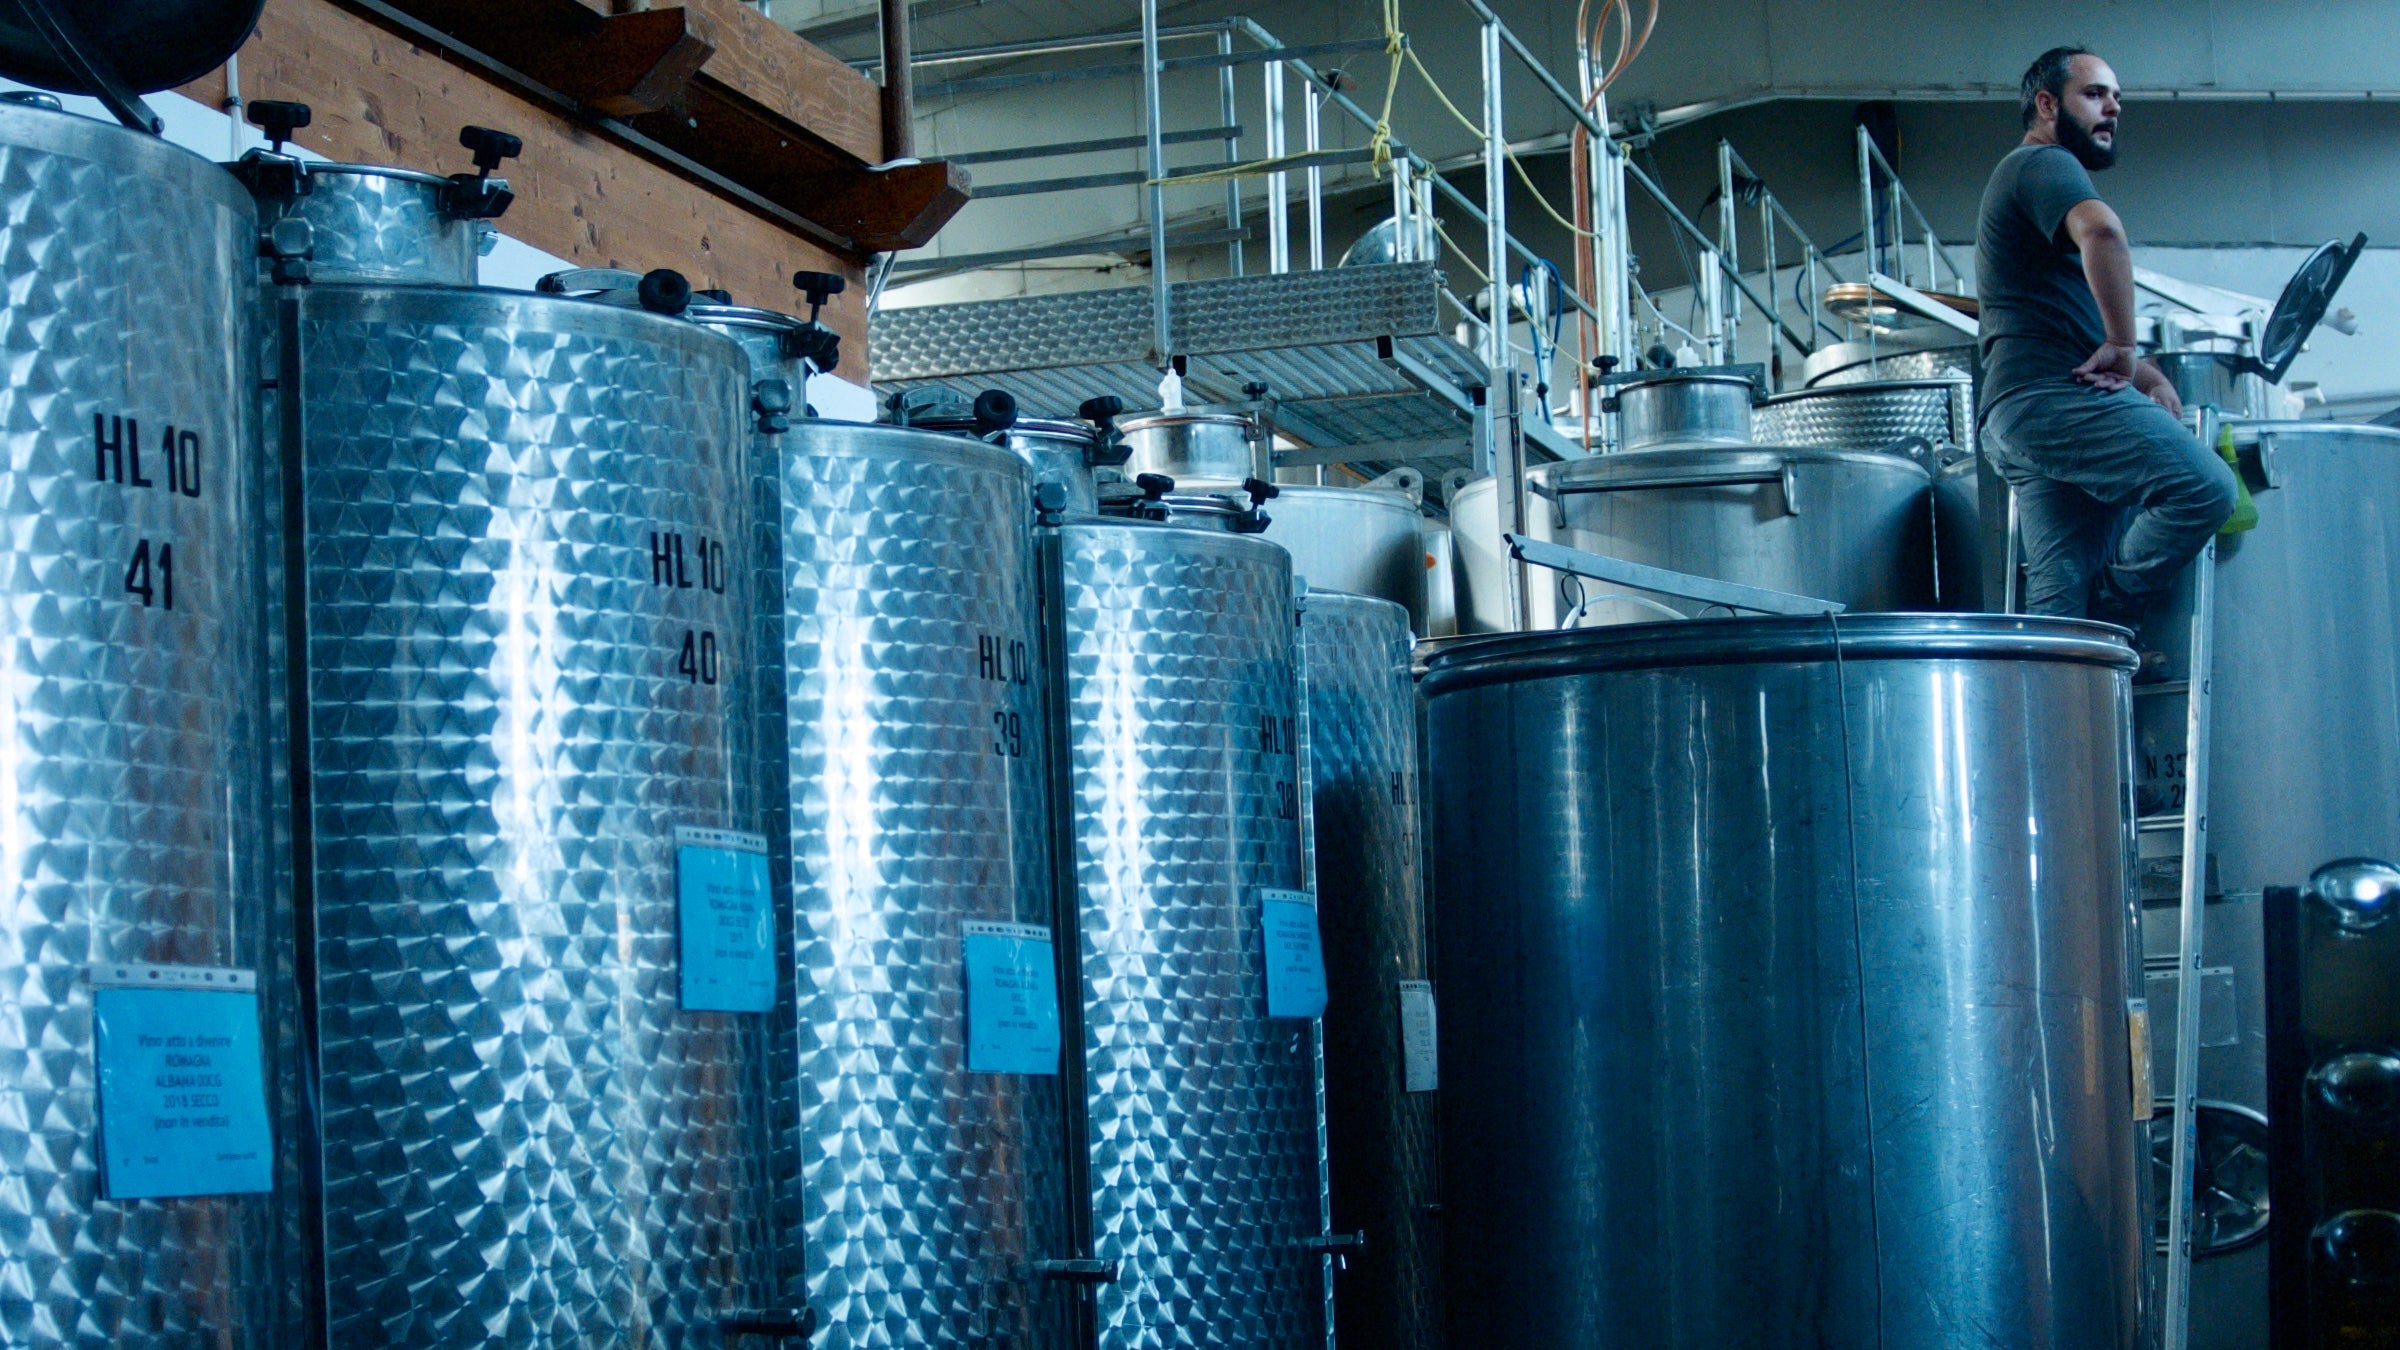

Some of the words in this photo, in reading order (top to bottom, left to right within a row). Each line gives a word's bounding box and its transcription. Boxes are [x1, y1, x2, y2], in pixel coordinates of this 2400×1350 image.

[94, 412, 152, 488] HL
[162, 425, 200, 498] 10
[125, 538, 172, 610] 41
[651, 531, 692, 588] HL
[698, 536, 724, 594] 10
[679, 630, 716, 685] 40
[979, 635, 1007, 682] HL
[1010, 639, 1027, 685] 10
[994, 711, 1020, 757] 39
[1261, 715, 1281, 754] HL
[1276, 781, 1294, 820] 38
[2170, 783, 2186, 808] 2
